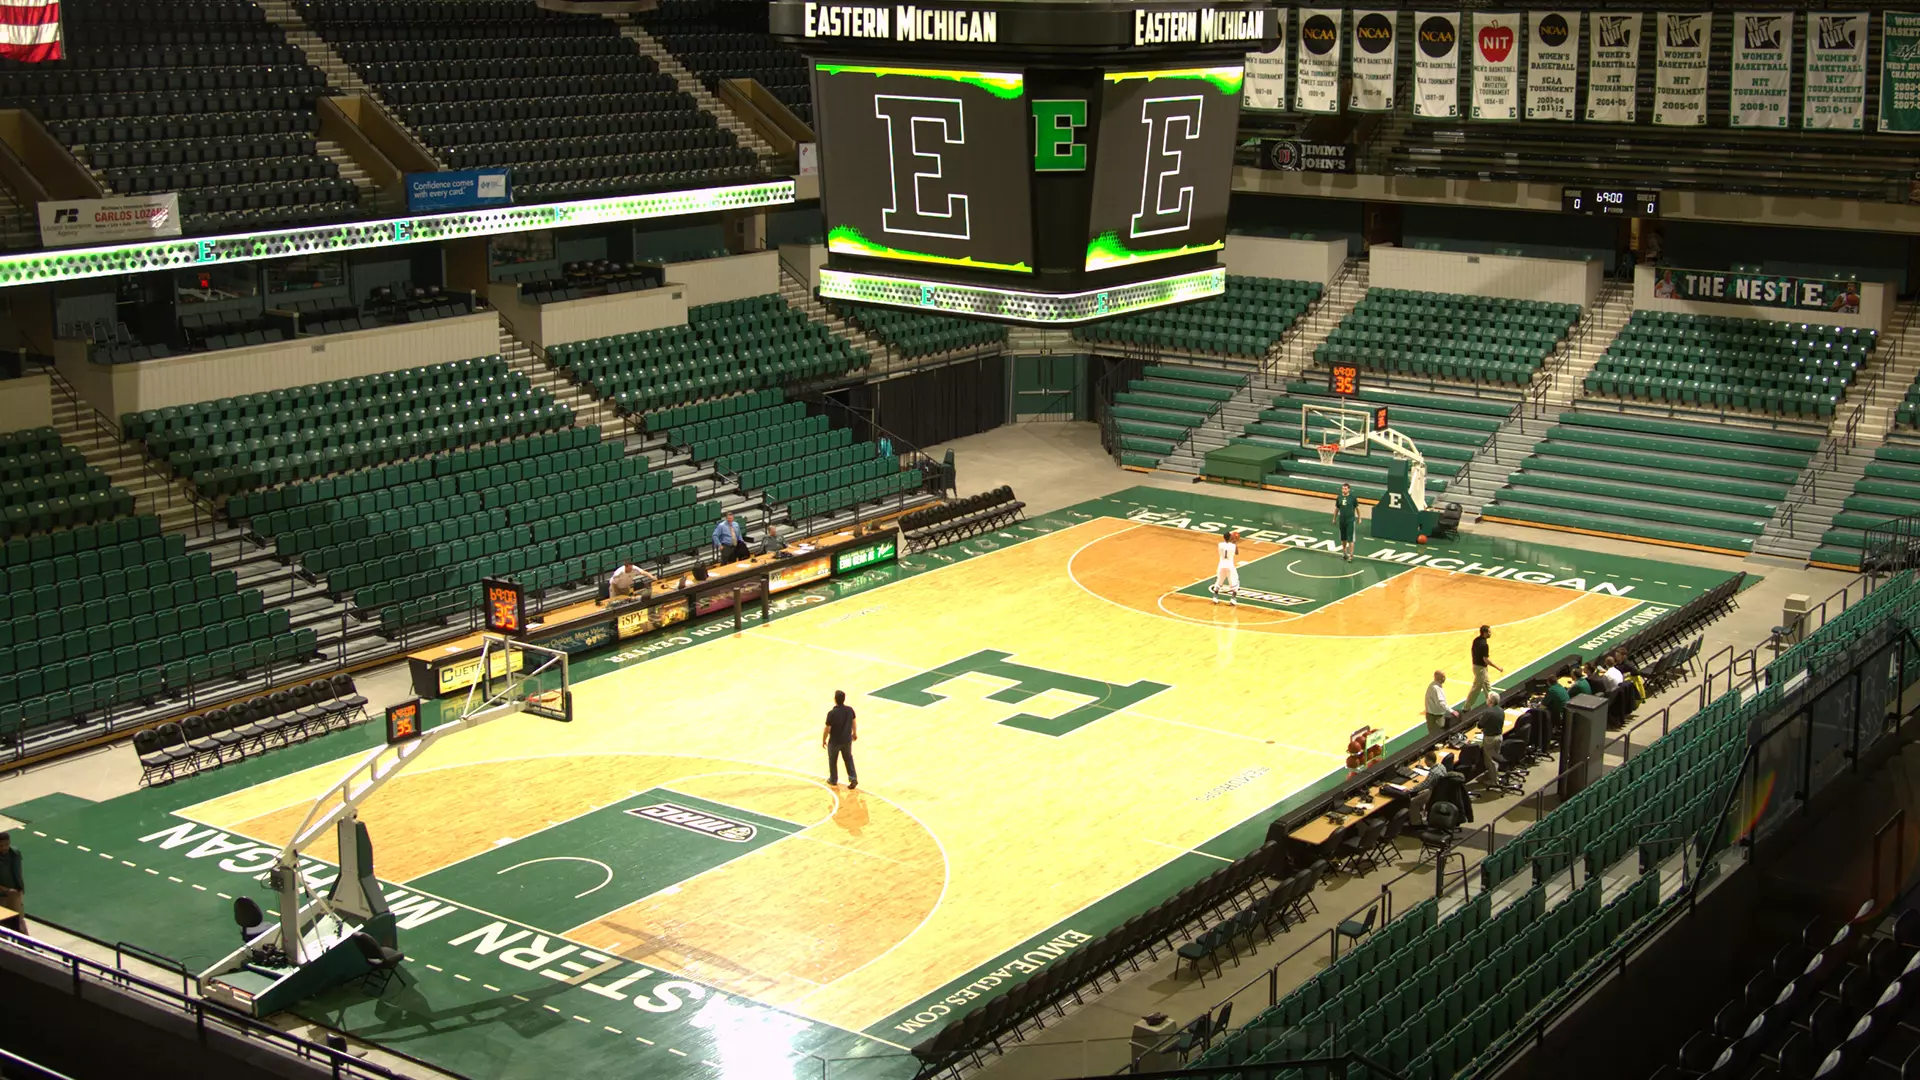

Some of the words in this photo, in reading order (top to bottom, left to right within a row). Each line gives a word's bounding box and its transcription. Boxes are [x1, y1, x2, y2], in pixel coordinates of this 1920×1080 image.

[804, 2, 889, 40] EASTERN
[896, 5, 997, 43] MICHIGAN
[1134, 9, 1196, 46] EASTERN
[1201, 9, 1264, 45] MICHIGAN
[1303, 28, 1335, 40] NCAA
[1358, 28, 1391, 39] NCAA
[1541, 26, 1567, 36] NCAA
[1421, 31, 1453, 42] NCAA
[1483, 36, 1509, 49] NIT
[1538, 52, 1570, 61] WOMEN'S
[1664, 51, 1702, 59] WOMEN'S
[1742, 52, 1783, 60] WOMEN'S
[1816, 54, 1857, 62] WOMEN'S
[1530, 62, 1575, 71] BASKETBALL
[1591, 60, 1636, 69] BASKETBALL
[1658, 60, 1707, 69] BASKETBALL
[1734, 62, 1788, 71] BASKETBALL
[1809, 64, 1863, 73] BASKETBALL
[1541, 76, 1562, 85] NCAA
[1752, 78, 1770, 87] NIT
[1529, 85, 1574, 93] TOURNAMENT
[1590, 84, 1634, 92] TOURNAMENT
[1657, 86, 1705, 95] TOURNAMENT
[1733, 88, 1787, 97] TOURNAMENT
[1808, 85, 1862, 93] TOURNAMENT
[1473, 107, 1480, 117] E
[1509, 107, 1516, 118] E
[1527, 107, 1534, 117] E
[1565, 109, 1572, 118] E
[1588, 110, 1595, 118] E
[1627, 111, 1634, 120] E
[1655, 114, 1662, 123] E
[1697, 115, 1705, 124] E
[1732, 116, 1740, 125] E
[1778, 116, 1786, 126] E
[1881, 119, 1888, 129] E
[1031, 99, 1088, 172] E
[1300, 144, 1346, 157] JIMMY
[874, 94, 971, 240] E
[1129, 94, 1204, 239] E
[1300, 158, 1346, 170] JOHN'S
[413, 180, 451, 190] Confidence
[413, 191, 428, 199] with
[429, 190, 448, 198] every
[1596, 192, 1623, 203] 69:00
[1574, 199, 1580, 209] 0
[1647, 203, 1654, 213] 0
[94, 211, 132, 222] CARLOS
[394, 222, 410, 241] E
[196, 240, 217, 262] E
[1686, 274, 1725, 298] THE
[1736, 278, 1791, 303] NEST
[1801, 283, 1823, 306] E
[920, 286, 935, 305] E
[1097, 293, 1109, 314] E
[1333, 366, 1356, 377] 69:00
[1335, 376, 1355, 394] 35
[1388, 492, 1402, 509] E
[1128, 511, 1349, 553] EASTERN
[1368, 548, 1636, 596] MICHIGAN
[1224, 550, 1228, 558] 1
[489, 587, 517, 605] 69:00
[493, 602, 517, 630] 35
[621, 611, 644, 627] iSPY
[604, 636, 693, 663] CENTER
[397, 717, 413, 737] 35
[894, 929, 1093, 1034] EMUEAGLES.COM
